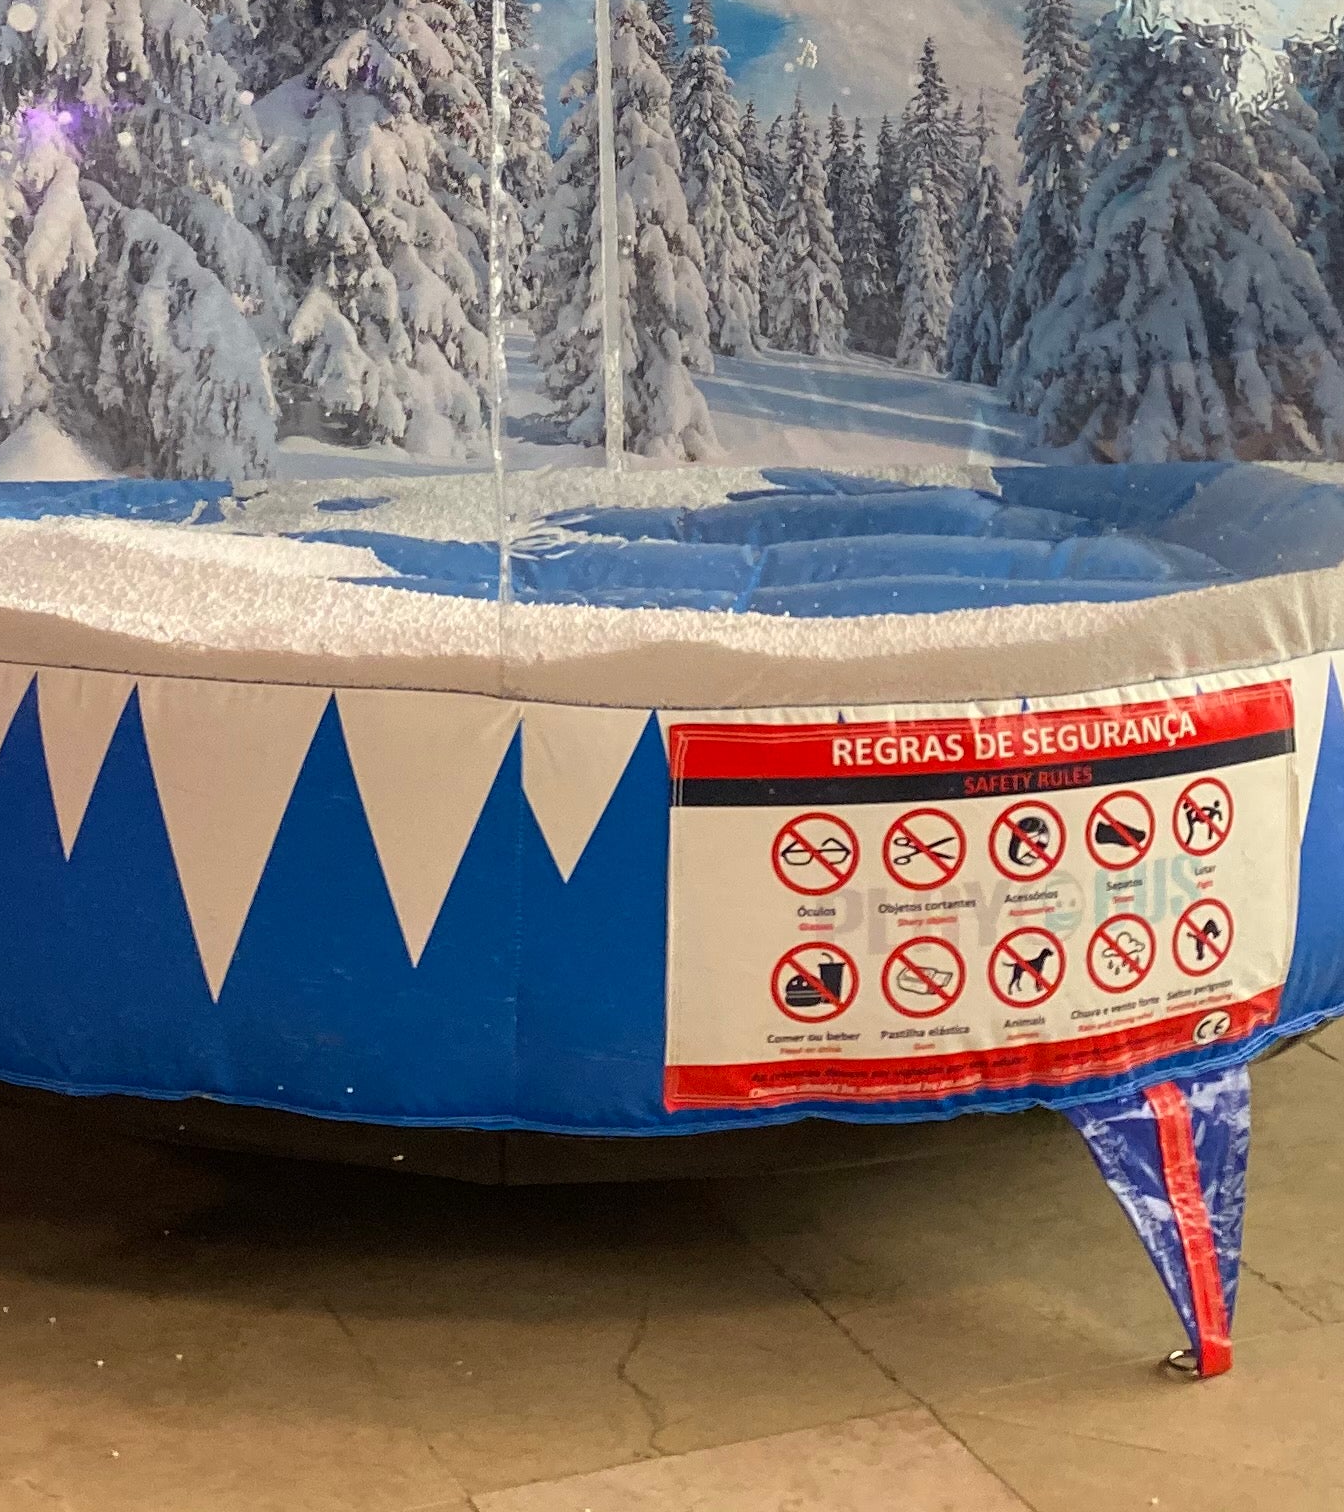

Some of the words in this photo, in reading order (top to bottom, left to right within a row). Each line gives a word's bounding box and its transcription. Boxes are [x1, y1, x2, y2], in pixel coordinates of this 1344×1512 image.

[832, 734, 965, 766] REGRAS
[974, 730, 1015, 760] DE
[1022, 712, 1197, 755] SEGURANÇA
[963, 770, 1031, 796] SAFETY
[1037, 766, 1093, 790] RULES
[797, 904, 836, 917] Óculos
[878, 903, 922, 915] Objetos
